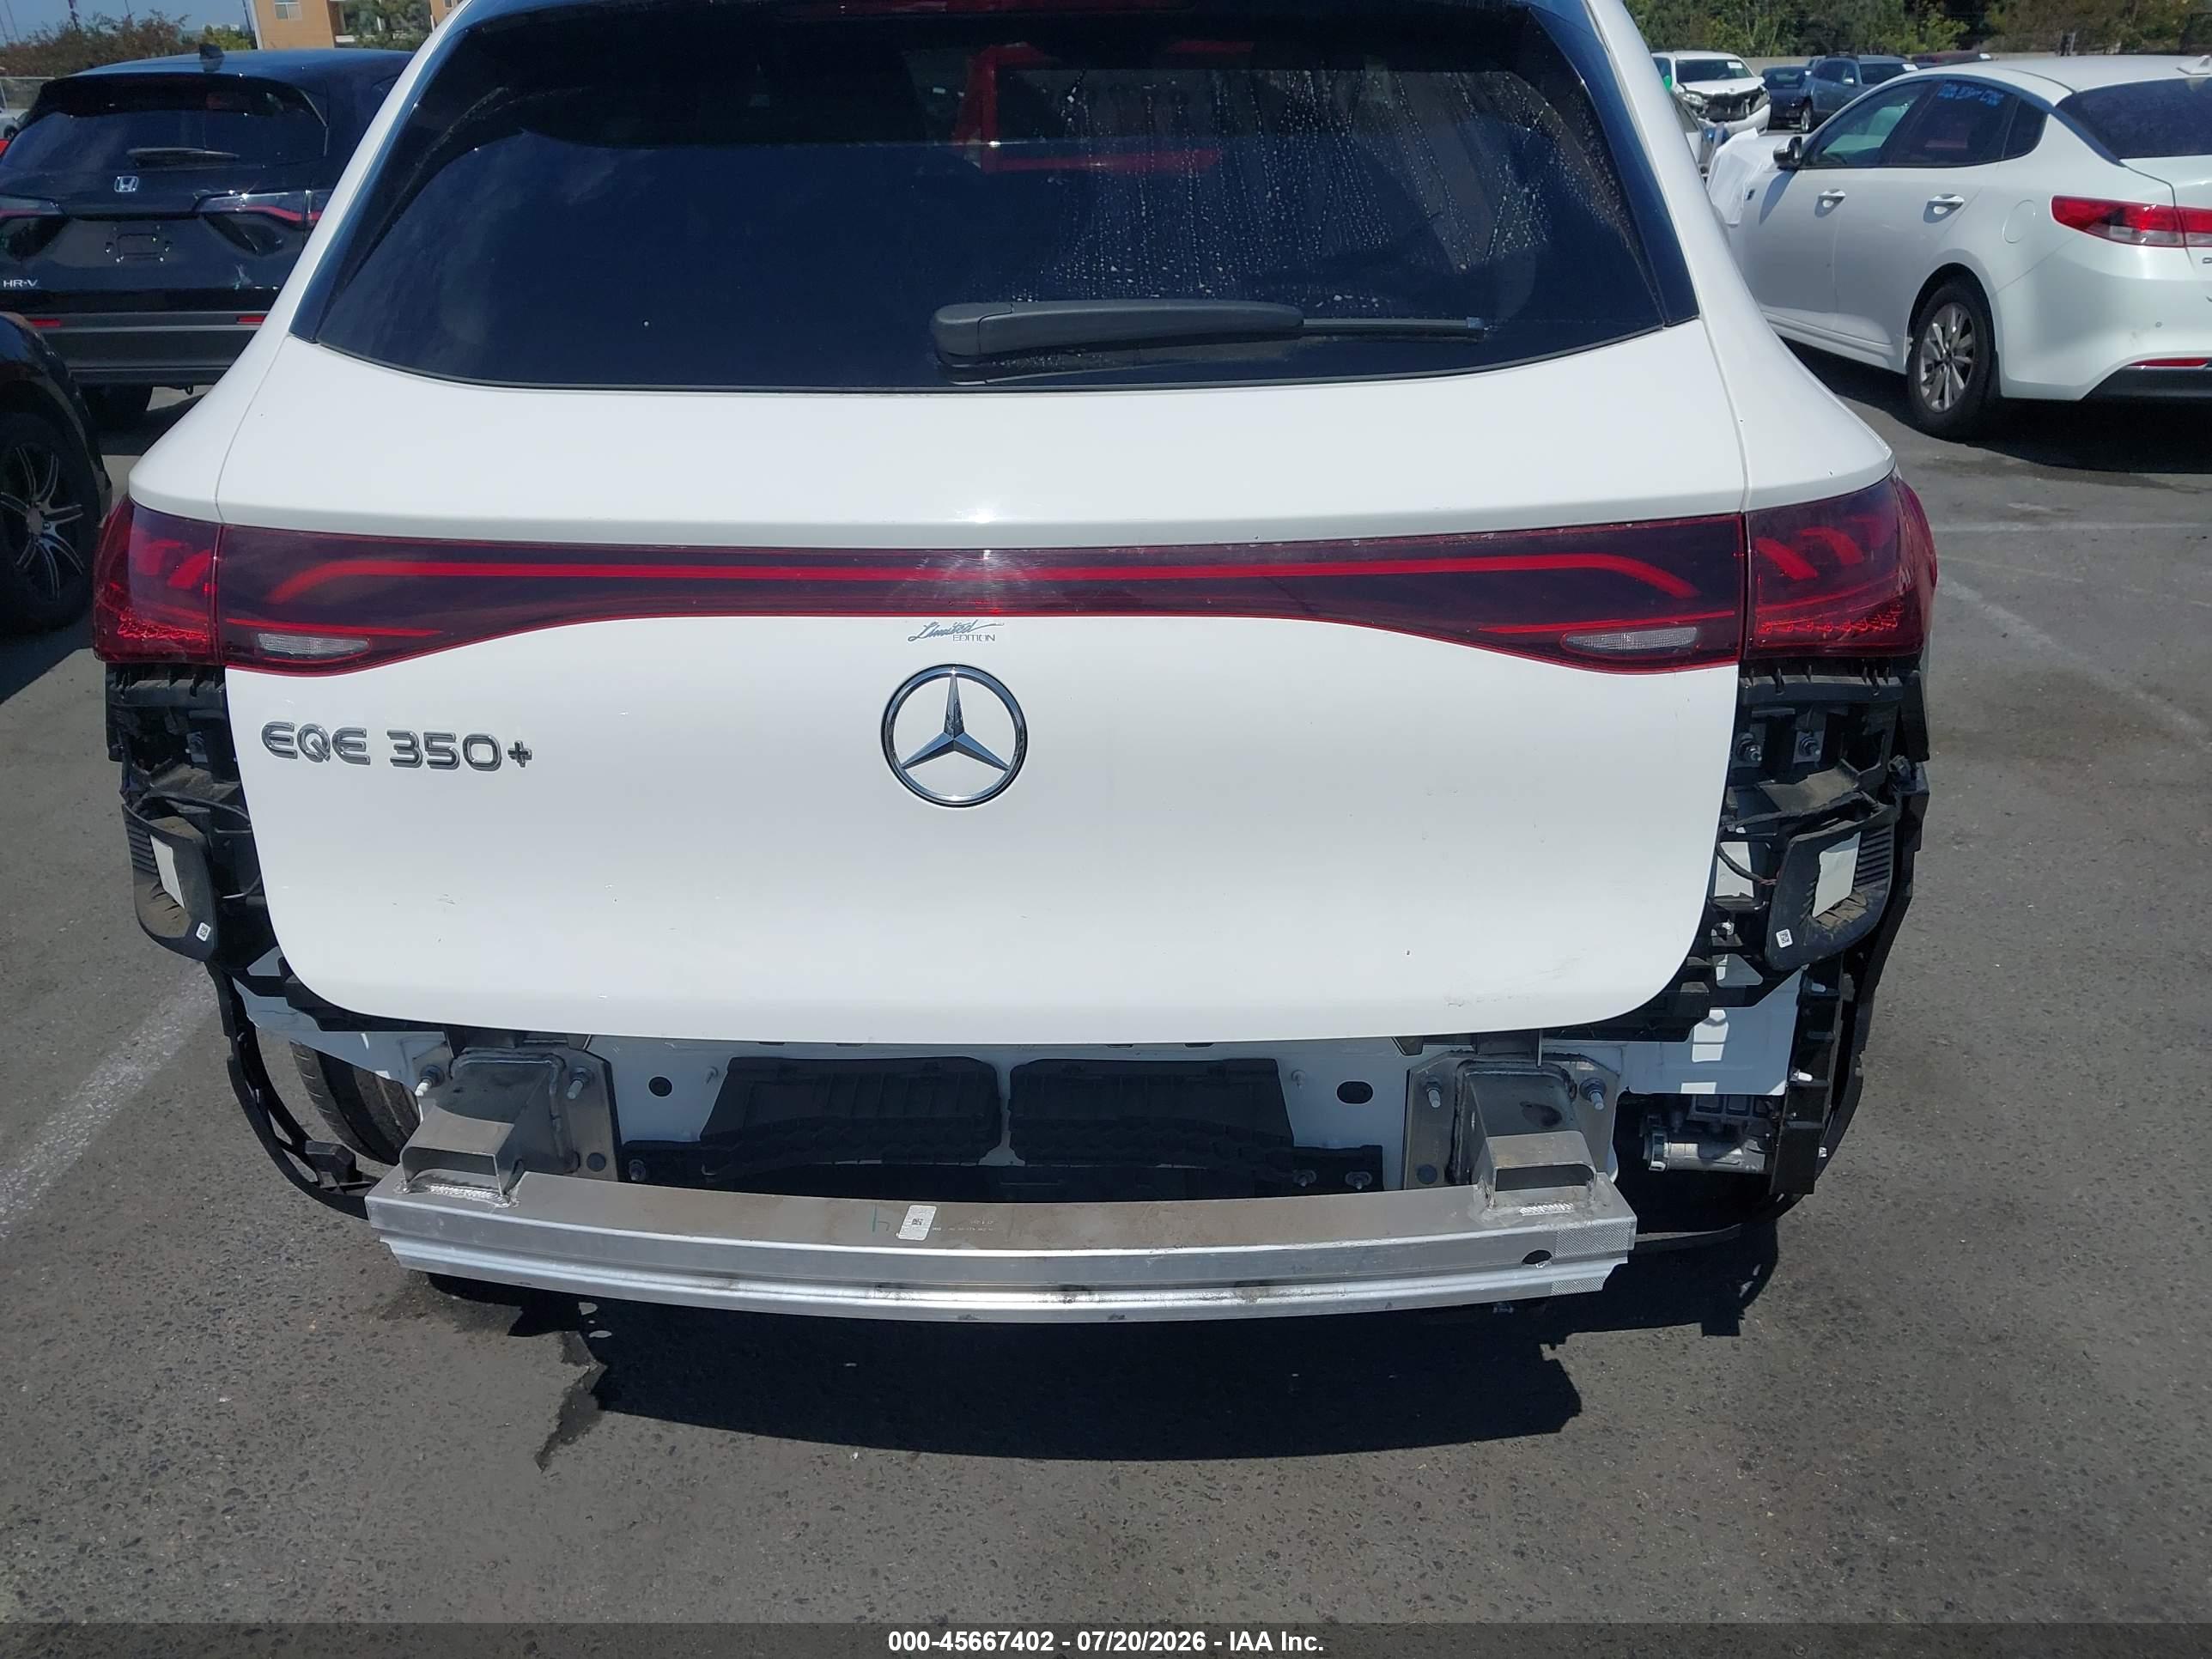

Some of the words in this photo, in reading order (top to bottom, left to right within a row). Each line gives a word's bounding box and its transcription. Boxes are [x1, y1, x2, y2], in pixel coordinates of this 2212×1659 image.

[3, 279, 39, 288] HR-V
[908, 619, 1005, 642] Limited
[952, 634, 996, 642] EDITION
[261, 721, 371, 766] EQE
[386, 729, 532, 772] 350+
